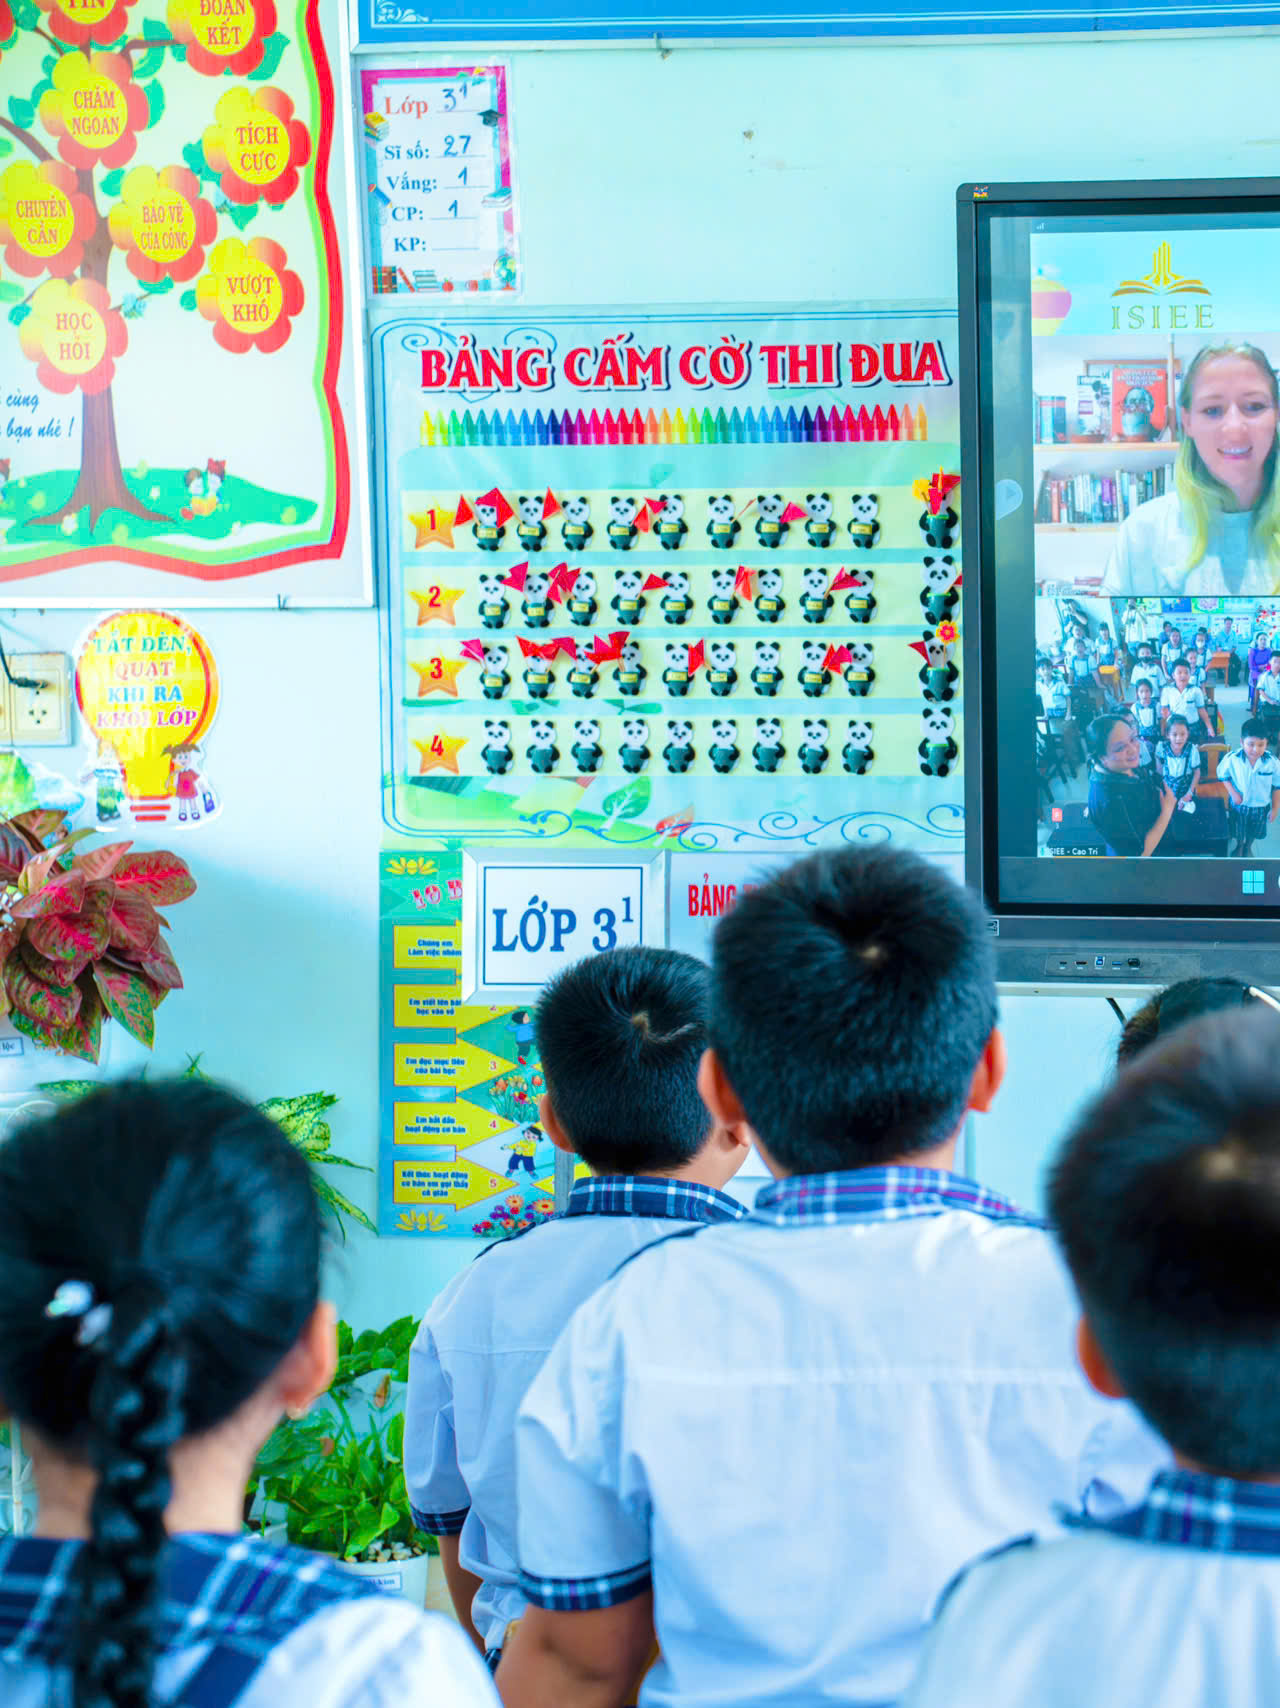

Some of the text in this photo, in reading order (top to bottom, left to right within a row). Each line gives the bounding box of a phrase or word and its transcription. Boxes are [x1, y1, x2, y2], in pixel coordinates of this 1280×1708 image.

[208, 17, 241, 45] KẾT
[385, 96, 429, 119] Lớp
[72, 117, 120, 136] NGOAN
[236, 121, 279, 145] TÍCH
[385, 135, 472, 160] Sĩ số: 27
[241, 150, 277, 175] CỰC
[386, 167, 468, 193] Vắng: 1
[16, 194, 67, 217] CHUYÊN
[391, 200, 459, 221] CP: 1
[394, 237, 427, 252] KP:
[227, 274, 274, 298] VƯỢT
[55, 313, 93, 335] HỌC
[1111, 304, 1215, 330] ISIEE
[420, 334, 551, 391] BẢNG
[678, 335, 750, 390] CỜ
[759, 342, 838, 387] THI
[848, 340, 951, 387] ĐUA
[6, 387, 39, 414] cùng
[7, 416, 33, 443] bạn
[38, 417, 62, 438] nhé
[426, 509, 436, 531] 1
[428, 586, 441, 608] 2
[115, 661, 174, 682] QUẠT
[430, 657, 443, 680] 3
[108, 685, 183, 702] KHI RA
[157, 704, 198, 726] LỚP
[430, 735, 444, 757] 4
[1071, 847, 1087, 856] Cao
[491, 895, 577, 953] LỚP
[488, 1060, 497, 1071] 3
[488, 1119, 497, 1129] 4
[488, 1177, 497, 1189] 5
